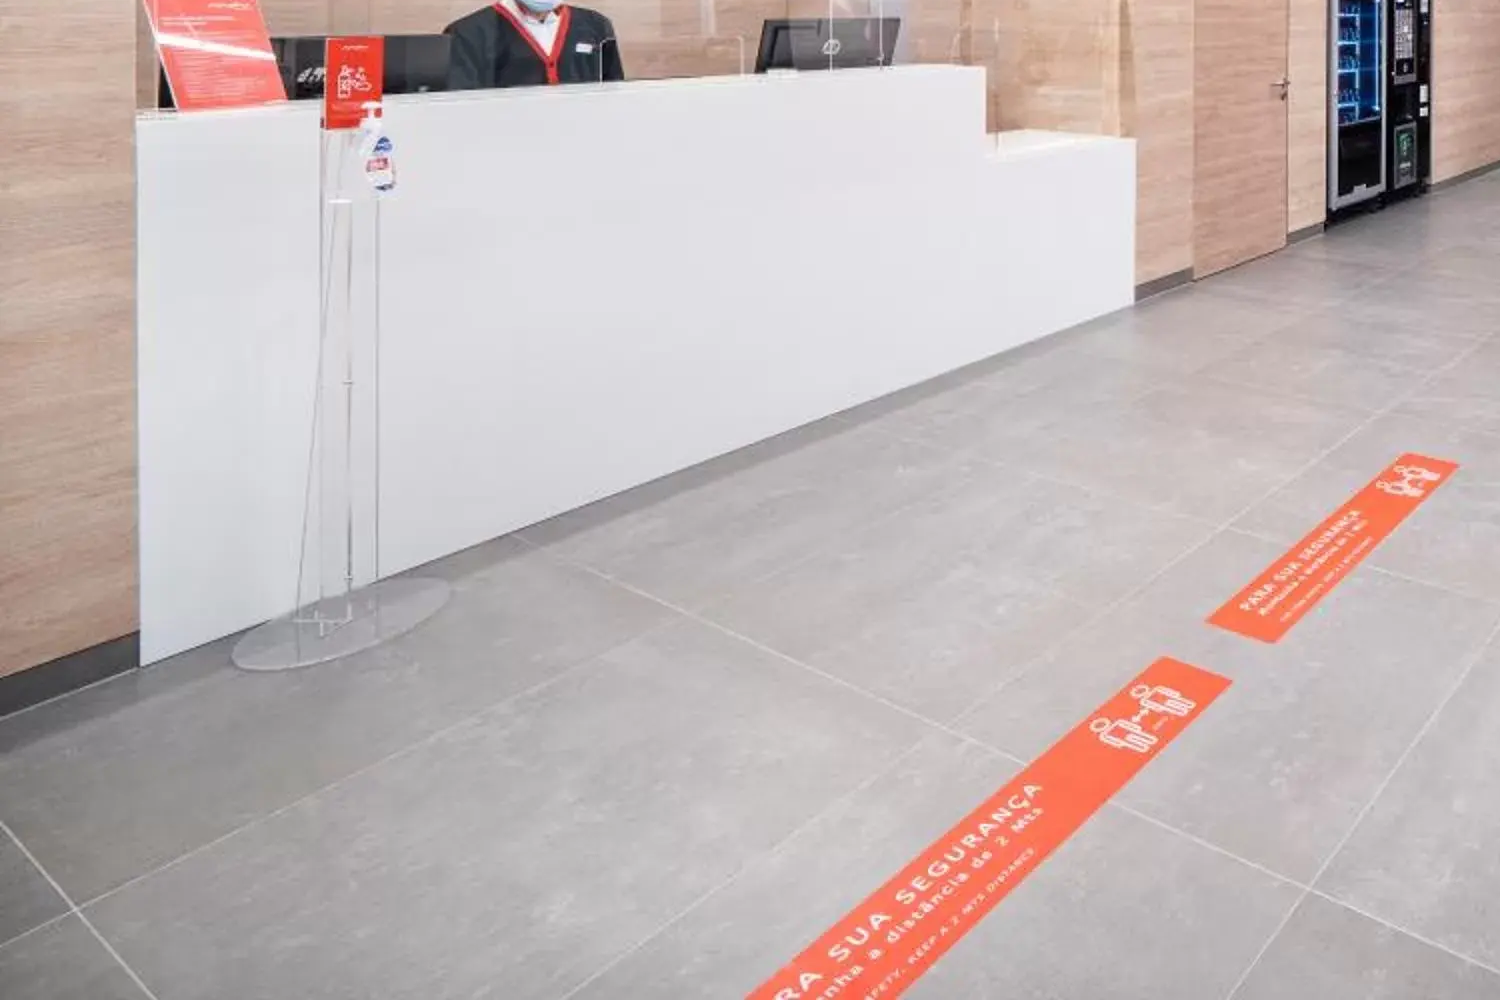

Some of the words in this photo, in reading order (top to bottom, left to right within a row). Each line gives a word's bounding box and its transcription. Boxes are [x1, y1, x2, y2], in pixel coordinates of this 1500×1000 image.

[773, 971, 824, 1000] RA
[827, 911, 893, 963] SUA
[895, 784, 1043, 905] SEGURANÇA
[886, 873, 969, 943] distância
[995, 834, 1009, 847] 2
